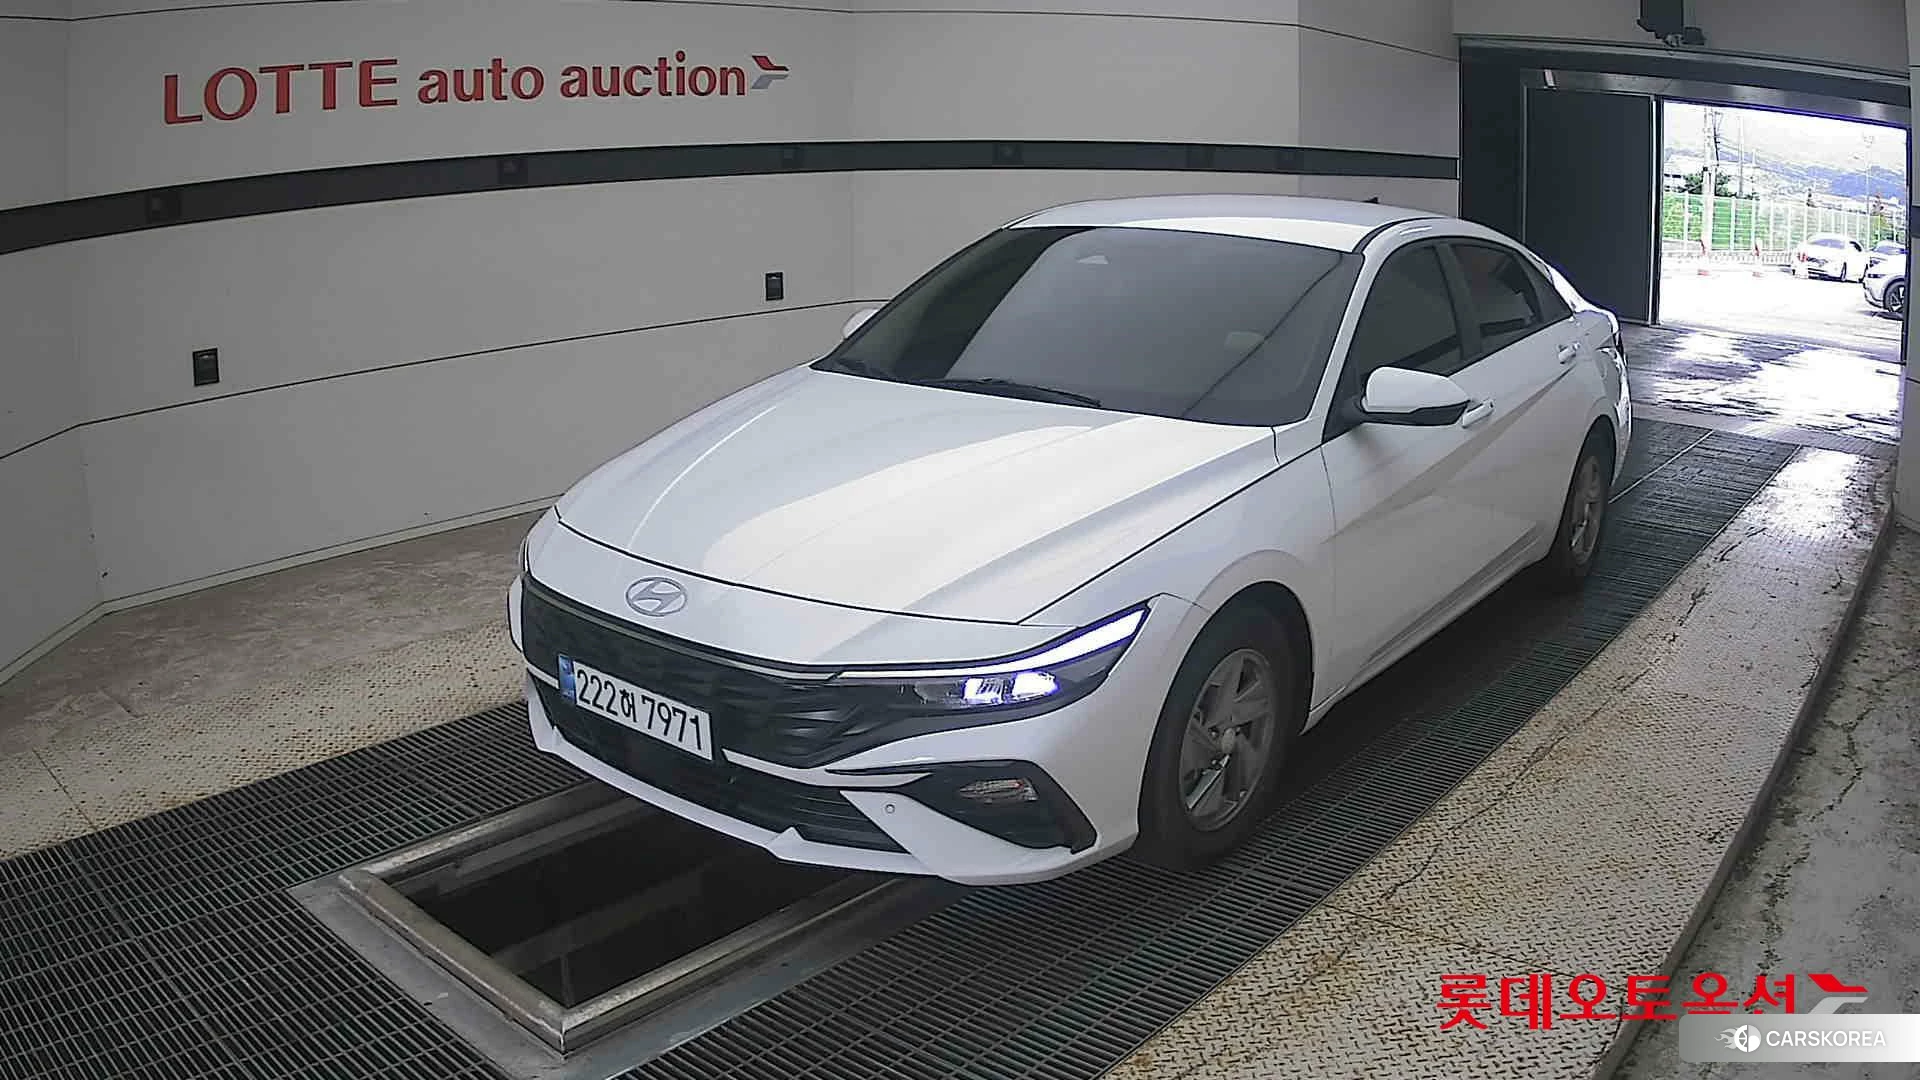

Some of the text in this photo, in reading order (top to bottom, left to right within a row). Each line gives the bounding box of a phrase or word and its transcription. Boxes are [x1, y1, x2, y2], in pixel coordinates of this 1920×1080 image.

[164, 50, 746, 125] LOTTE auto auction
